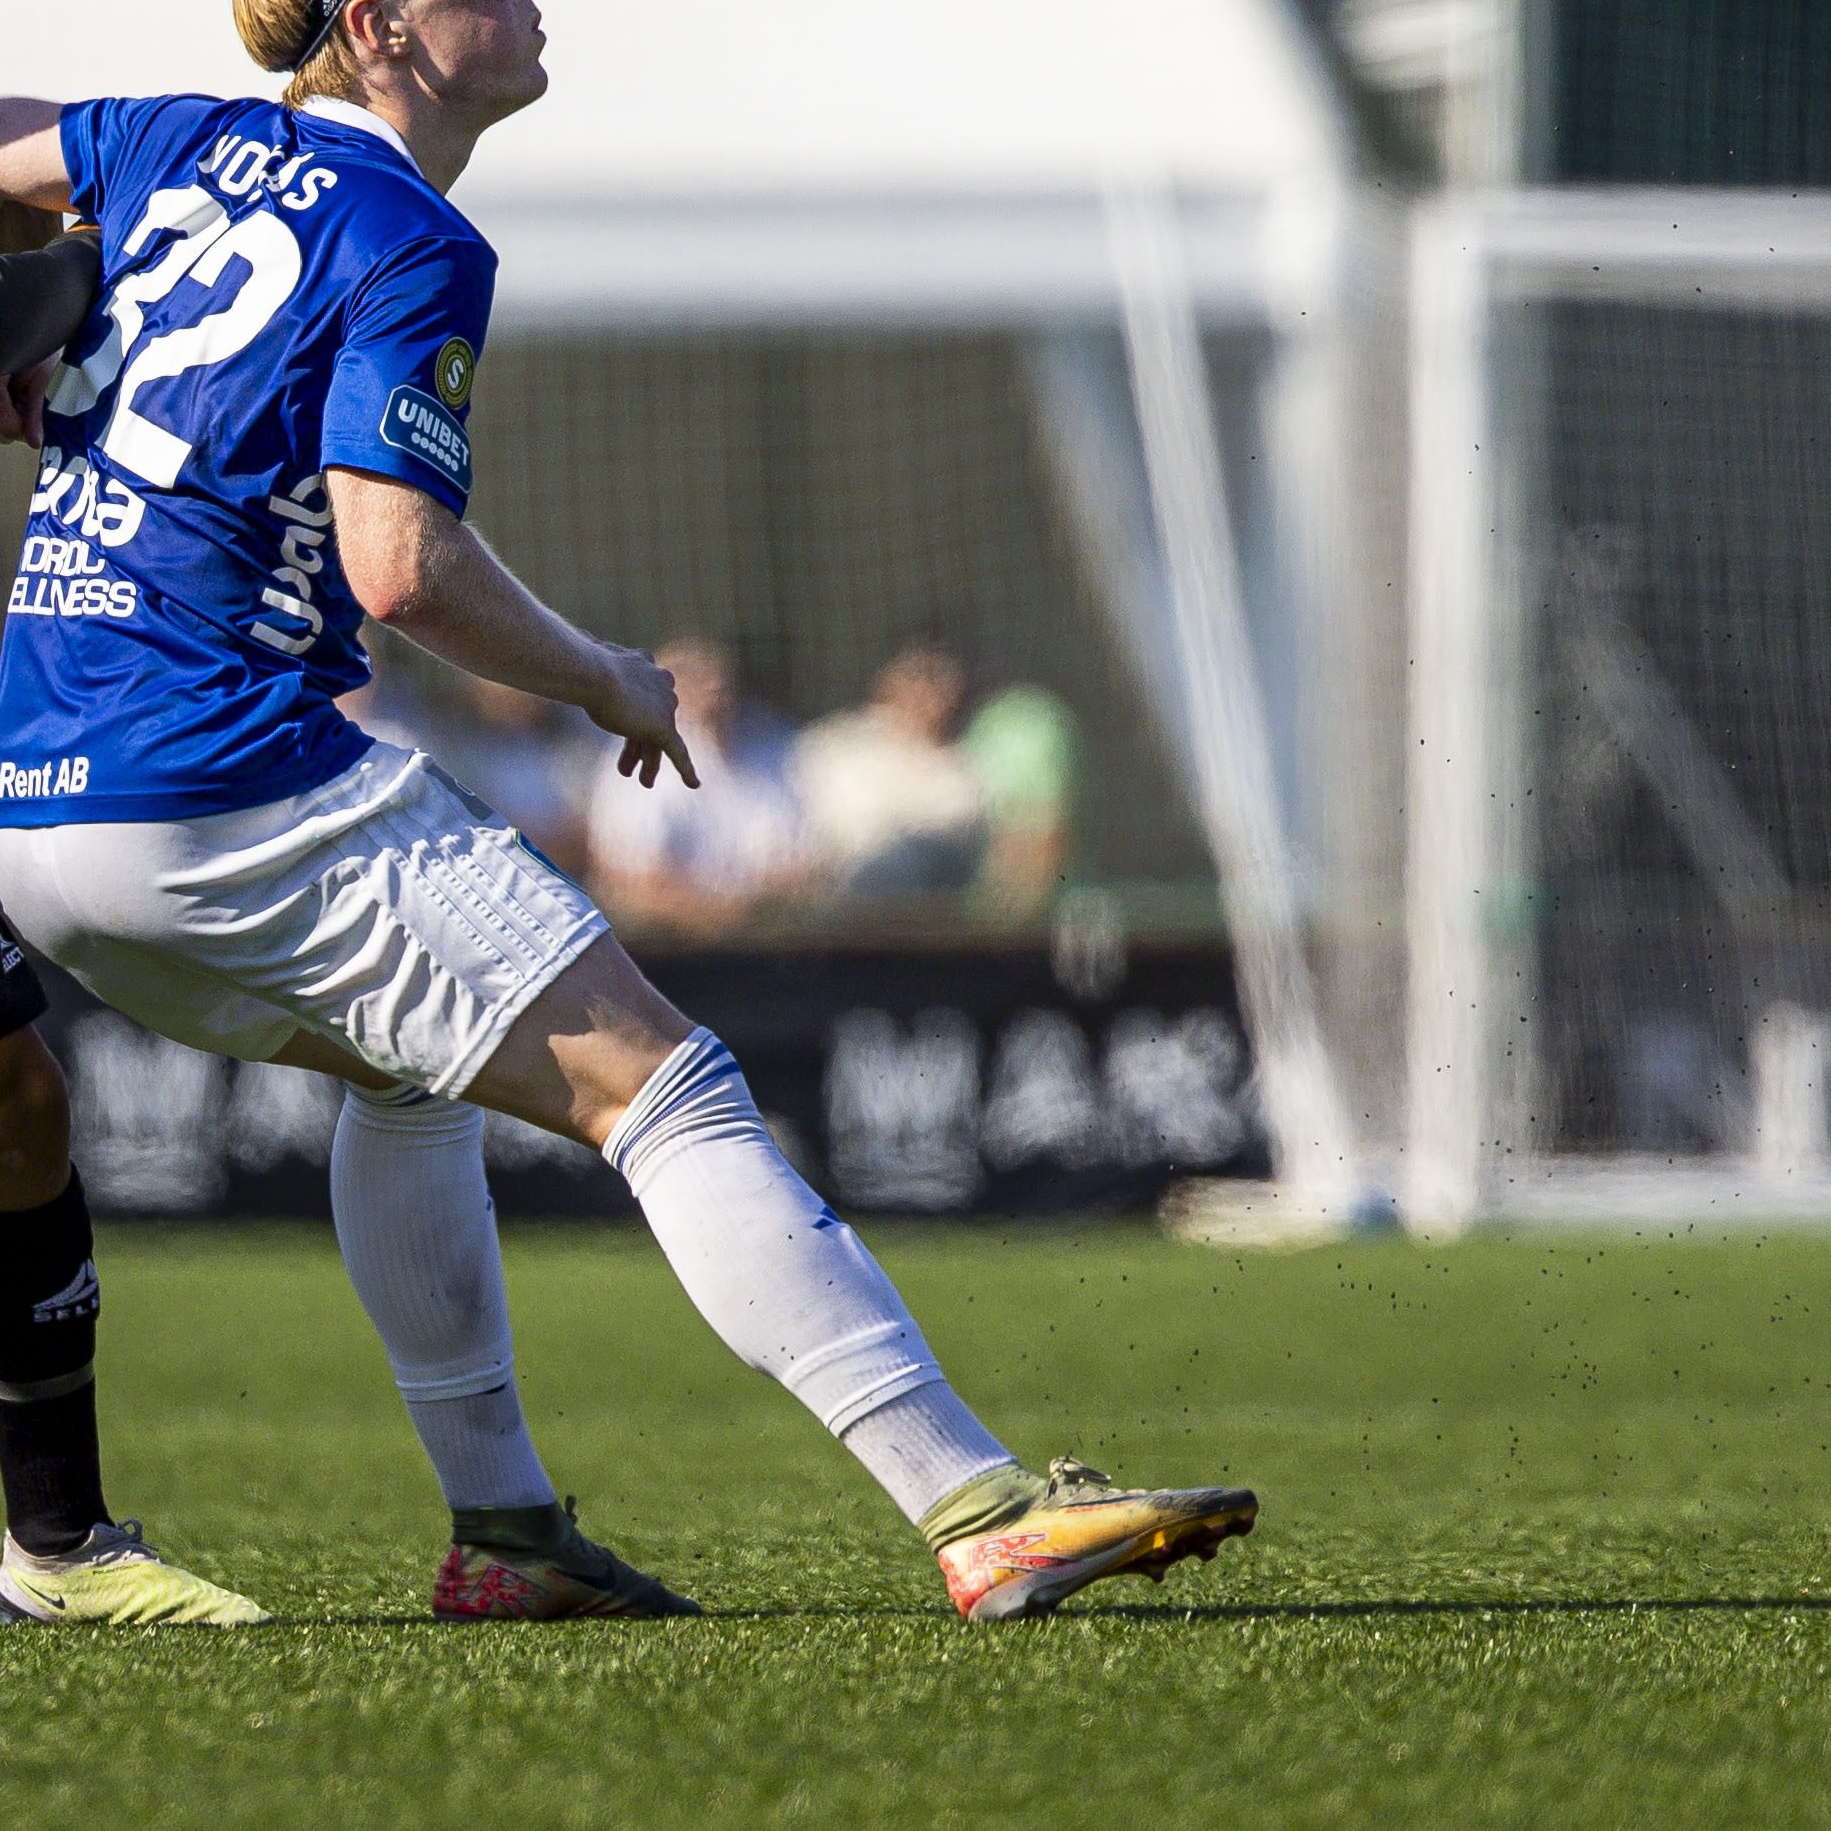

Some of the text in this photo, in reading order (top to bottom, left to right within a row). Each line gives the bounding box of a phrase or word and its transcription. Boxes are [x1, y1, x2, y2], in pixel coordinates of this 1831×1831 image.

[397, 398, 470, 468] UNIBET
[7, 576, 138, 618] ELLNESS
[53, 756, 90, 796] AB
[33, 1296, 99, 1323] SEL
